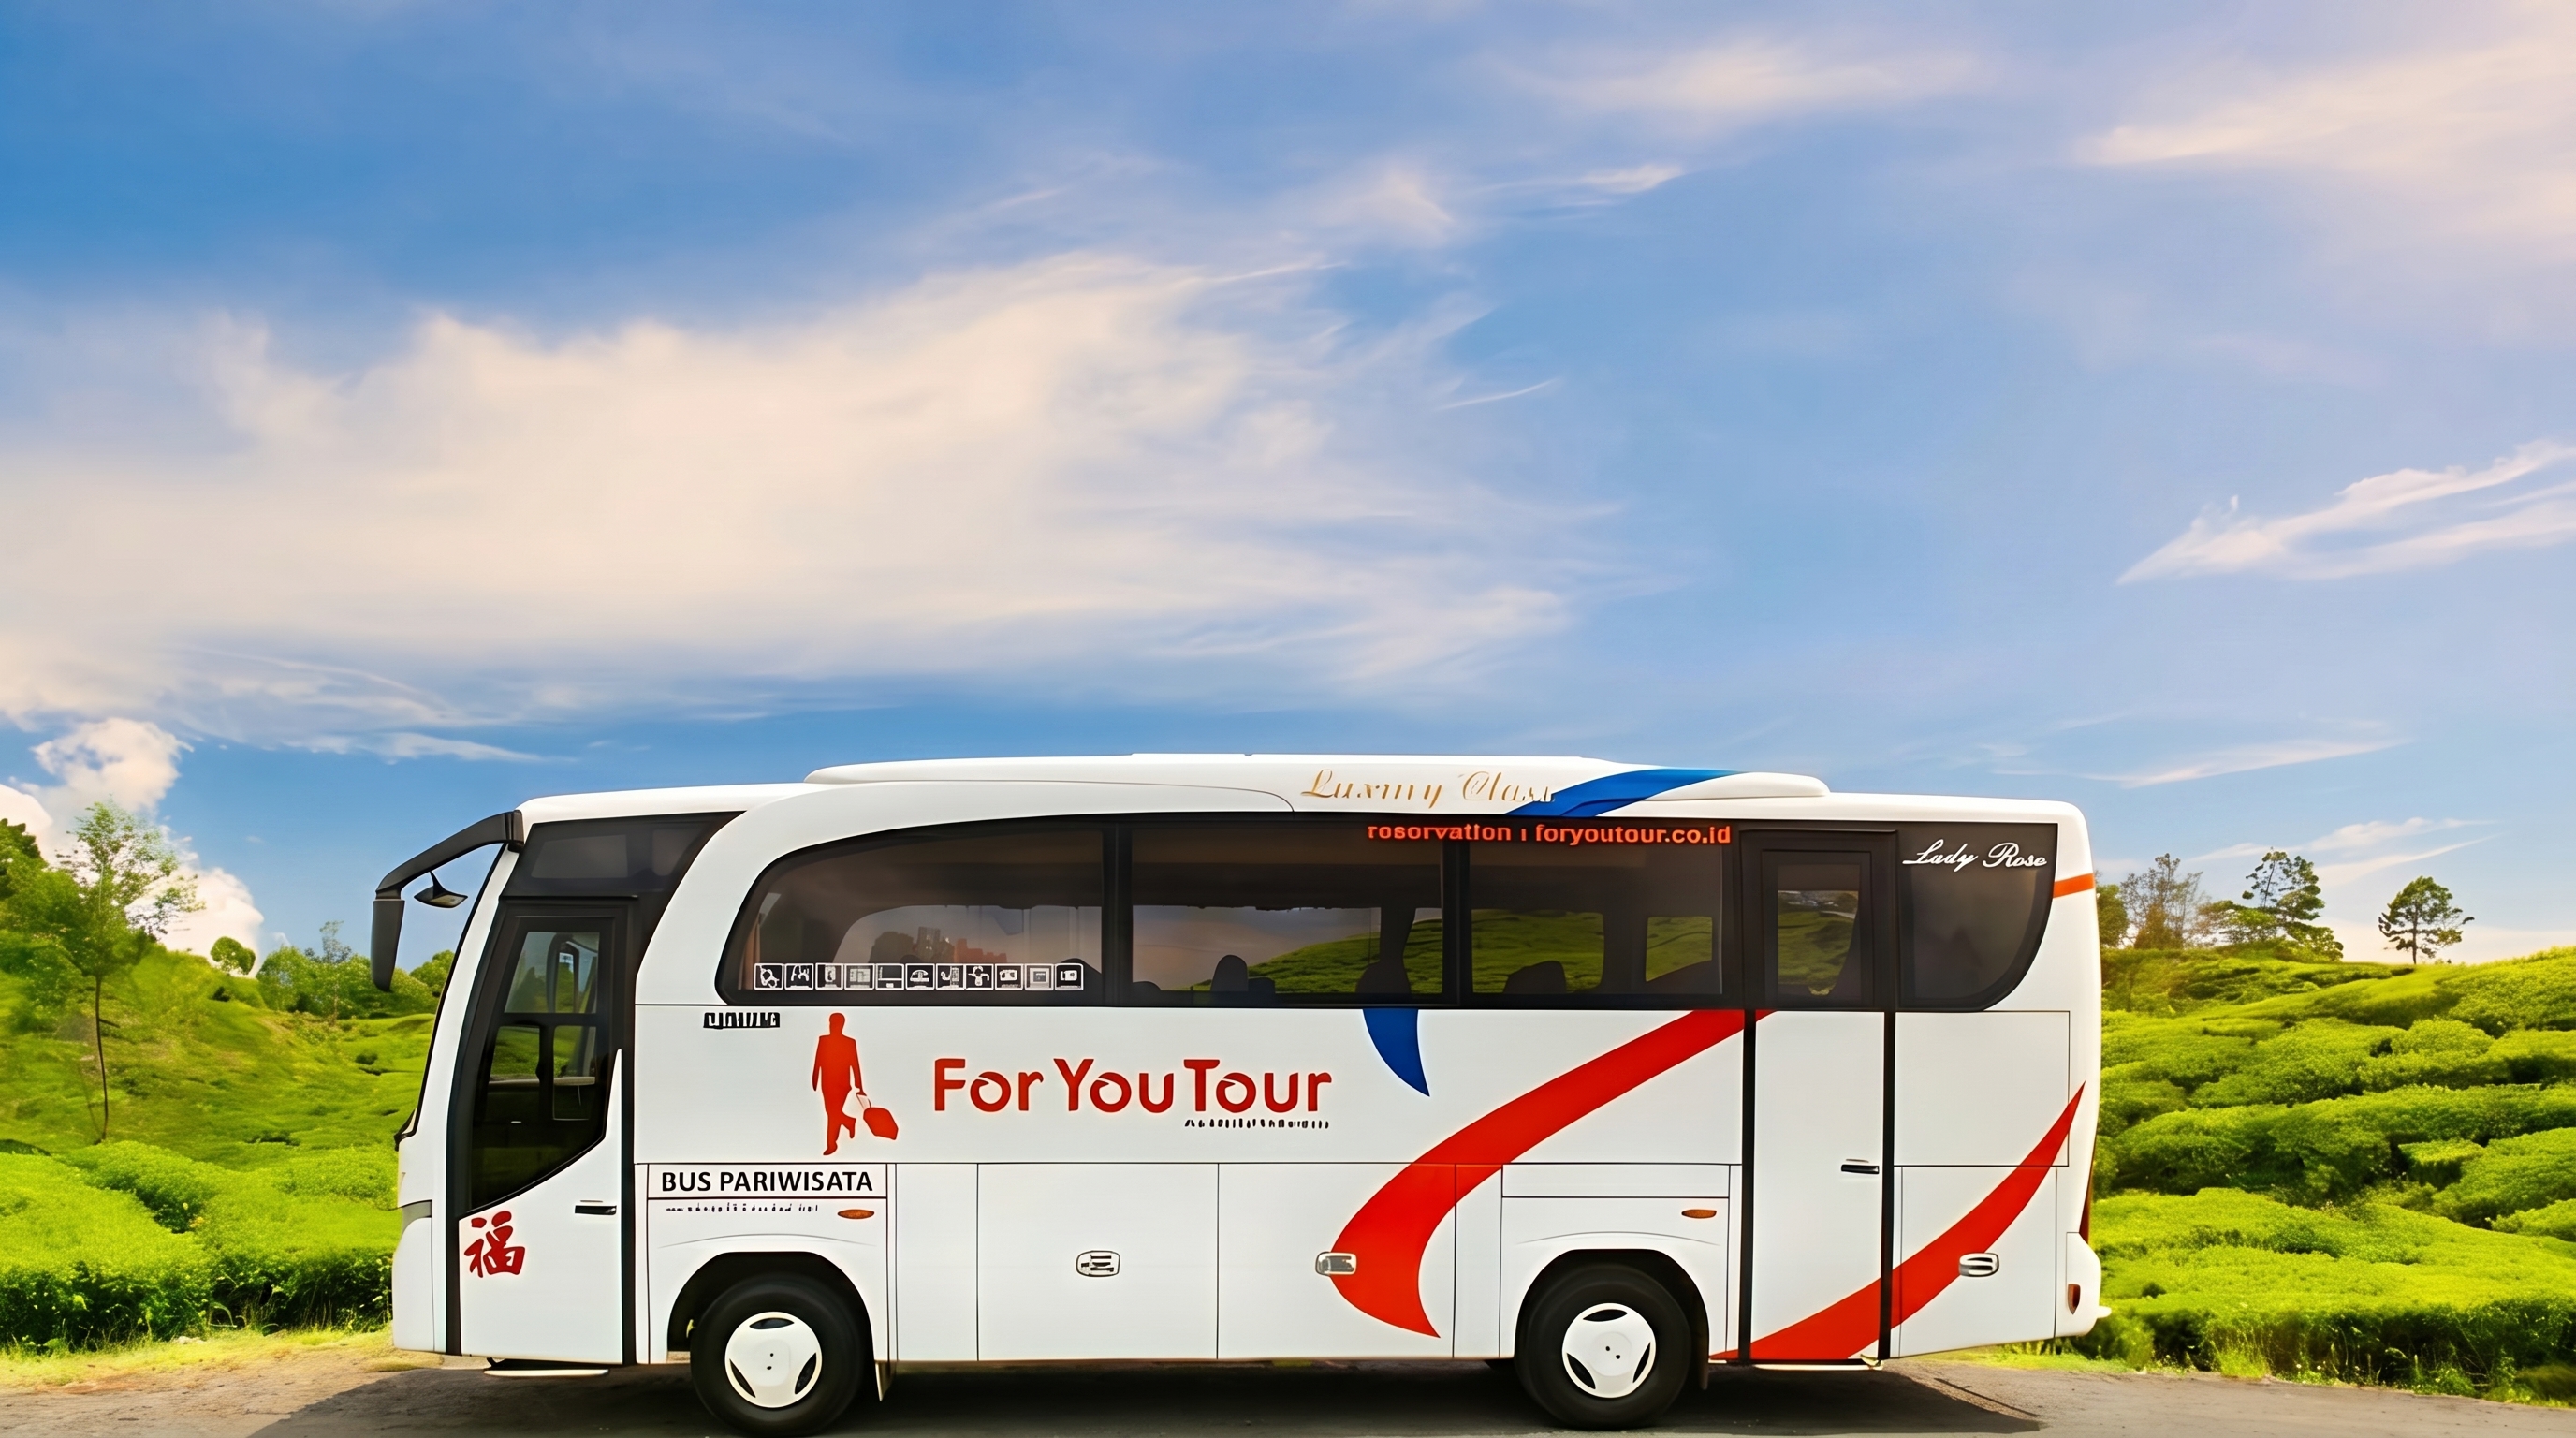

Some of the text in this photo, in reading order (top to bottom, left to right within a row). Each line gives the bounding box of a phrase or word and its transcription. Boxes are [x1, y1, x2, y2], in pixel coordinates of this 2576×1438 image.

[1535, 824, 1731, 846] foryoutour.co.id
[1902, 839, 2047, 873] Lady Rose
[934, 1058, 1332, 1113] For You Tour
[662, 1171, 873, 1192] BUS PARIWISATA
